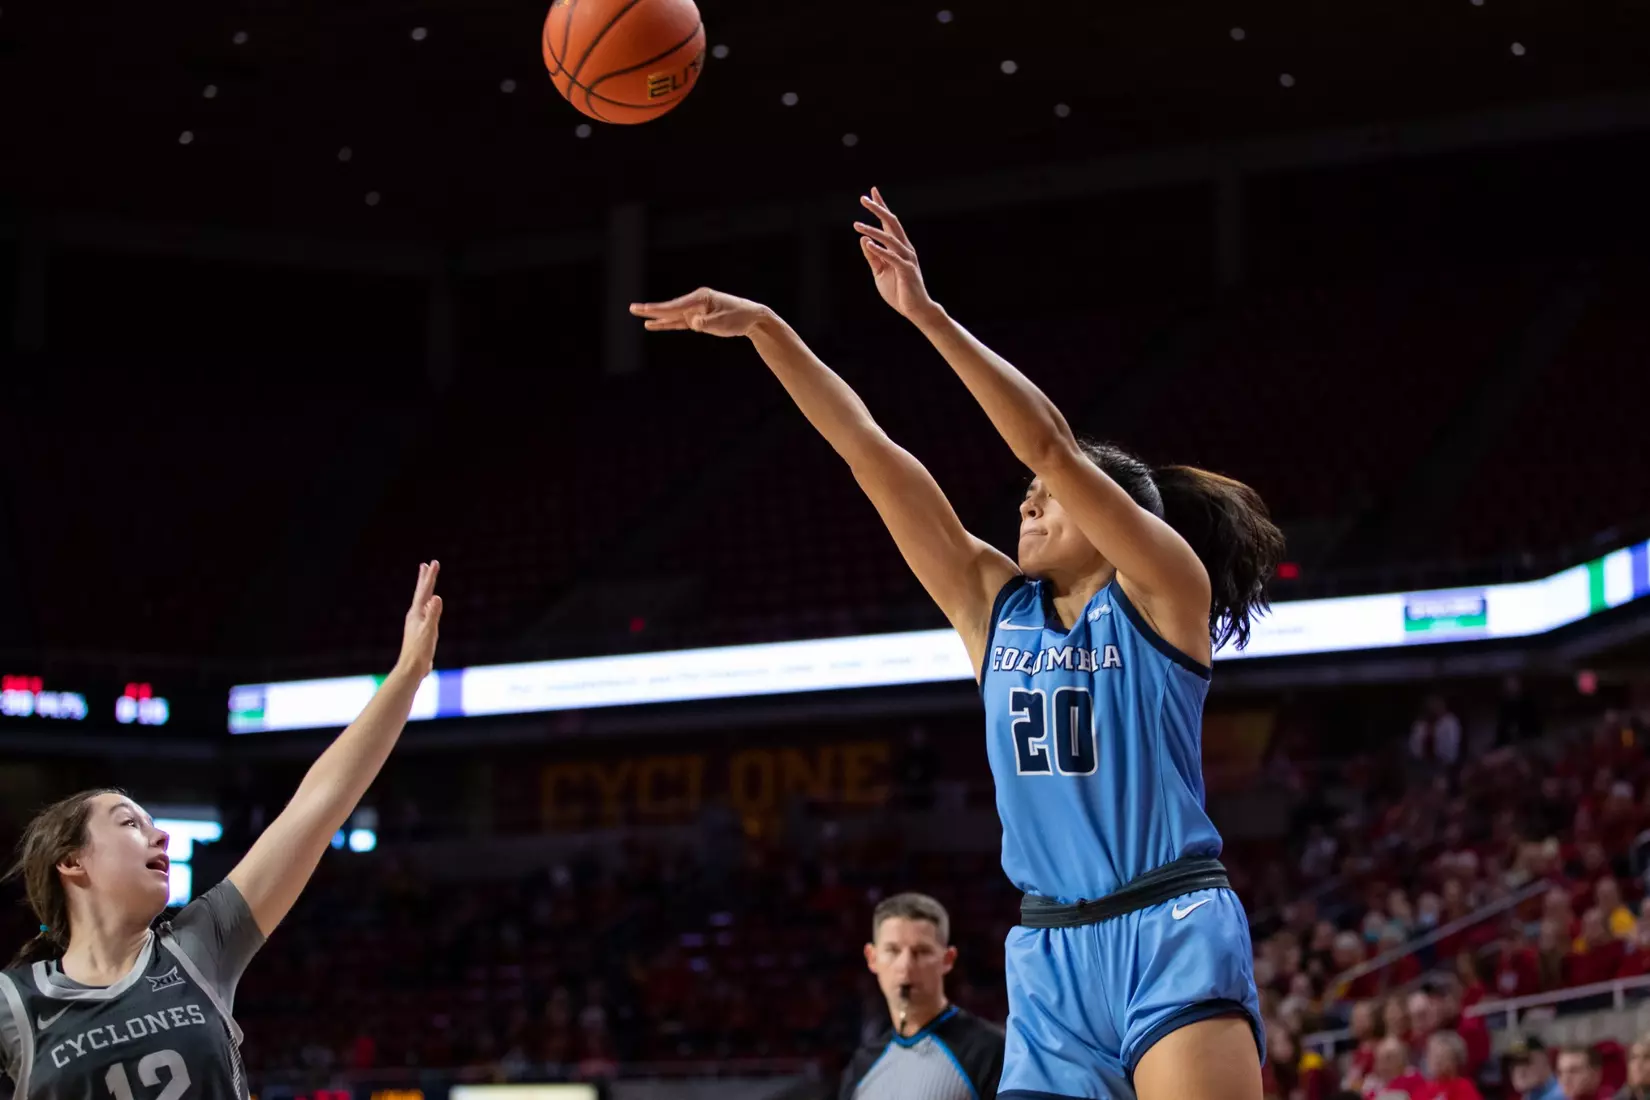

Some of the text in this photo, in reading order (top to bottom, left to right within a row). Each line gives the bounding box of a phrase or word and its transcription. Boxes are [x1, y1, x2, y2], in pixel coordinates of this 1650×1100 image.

[1009, 686, 1098, 776] 20
[50, 1004, 206, 1069] CYCLONES
[104, 1049, 192, 1100] 12
